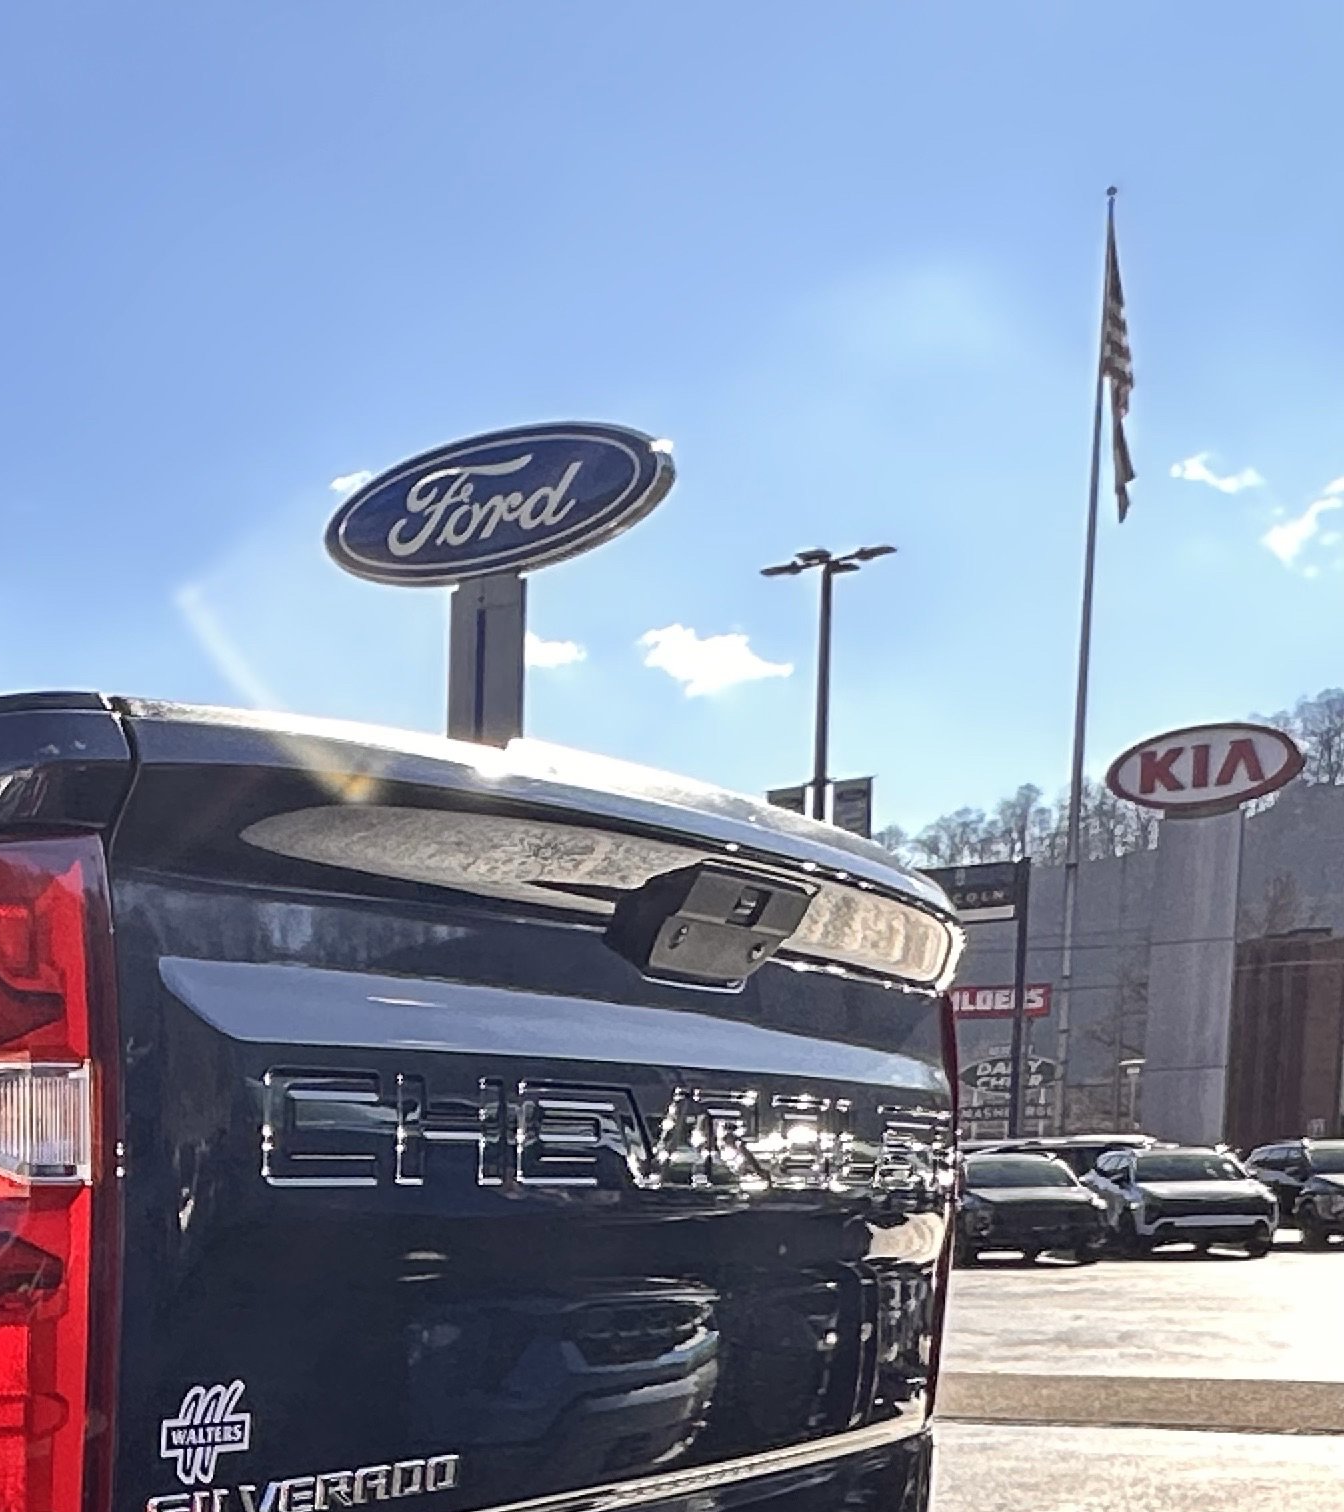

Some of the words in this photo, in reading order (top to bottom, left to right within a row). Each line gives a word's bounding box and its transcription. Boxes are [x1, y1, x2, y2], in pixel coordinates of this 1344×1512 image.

[387, 453, 584, 556] Ford
[1138, 738, 1266, 795] KIA
[952, 889, 1005, 905] COLN
[170, 1424, 243, 1446] WALTERS
